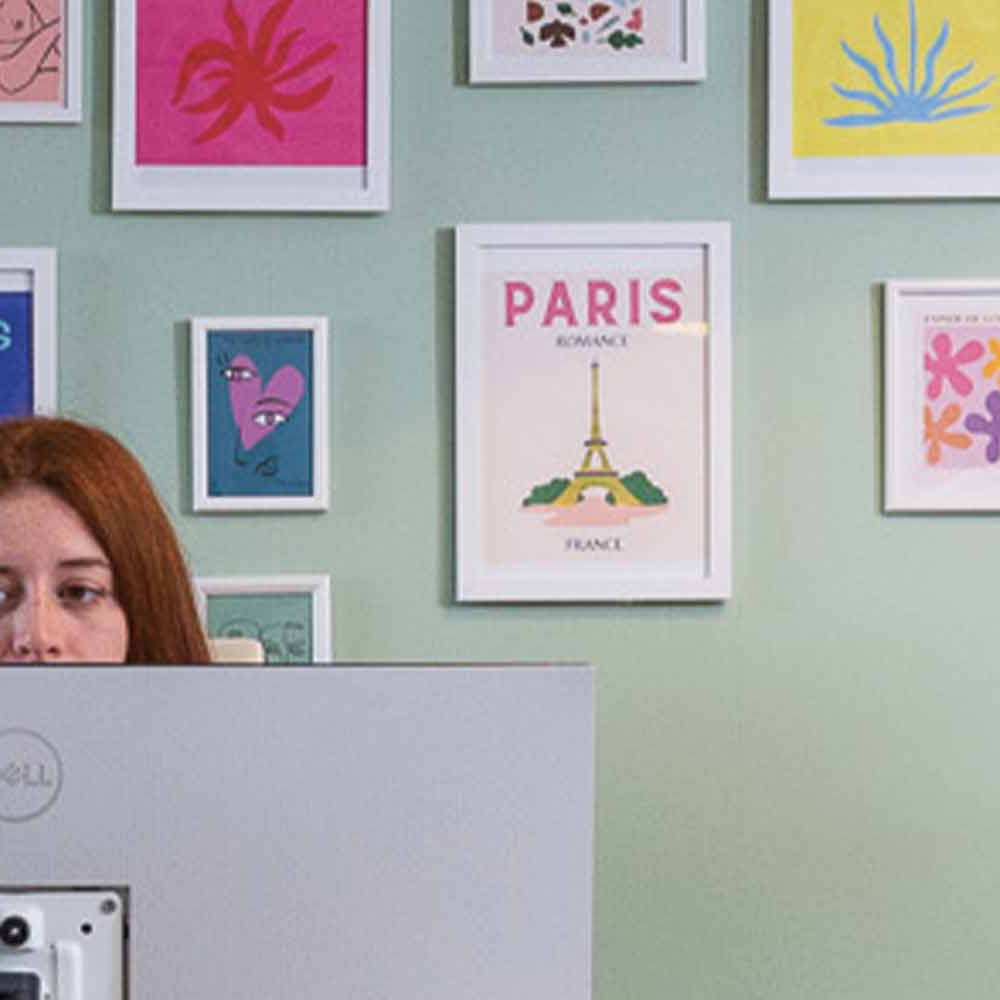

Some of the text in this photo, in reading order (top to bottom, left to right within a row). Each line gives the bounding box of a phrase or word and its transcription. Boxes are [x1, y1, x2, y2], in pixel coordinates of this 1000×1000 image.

[504, 278, 683, 327] PARIS
[556, 334, 628, 348] ROMANCE
[564, 536, 623, 552] FRANCE
